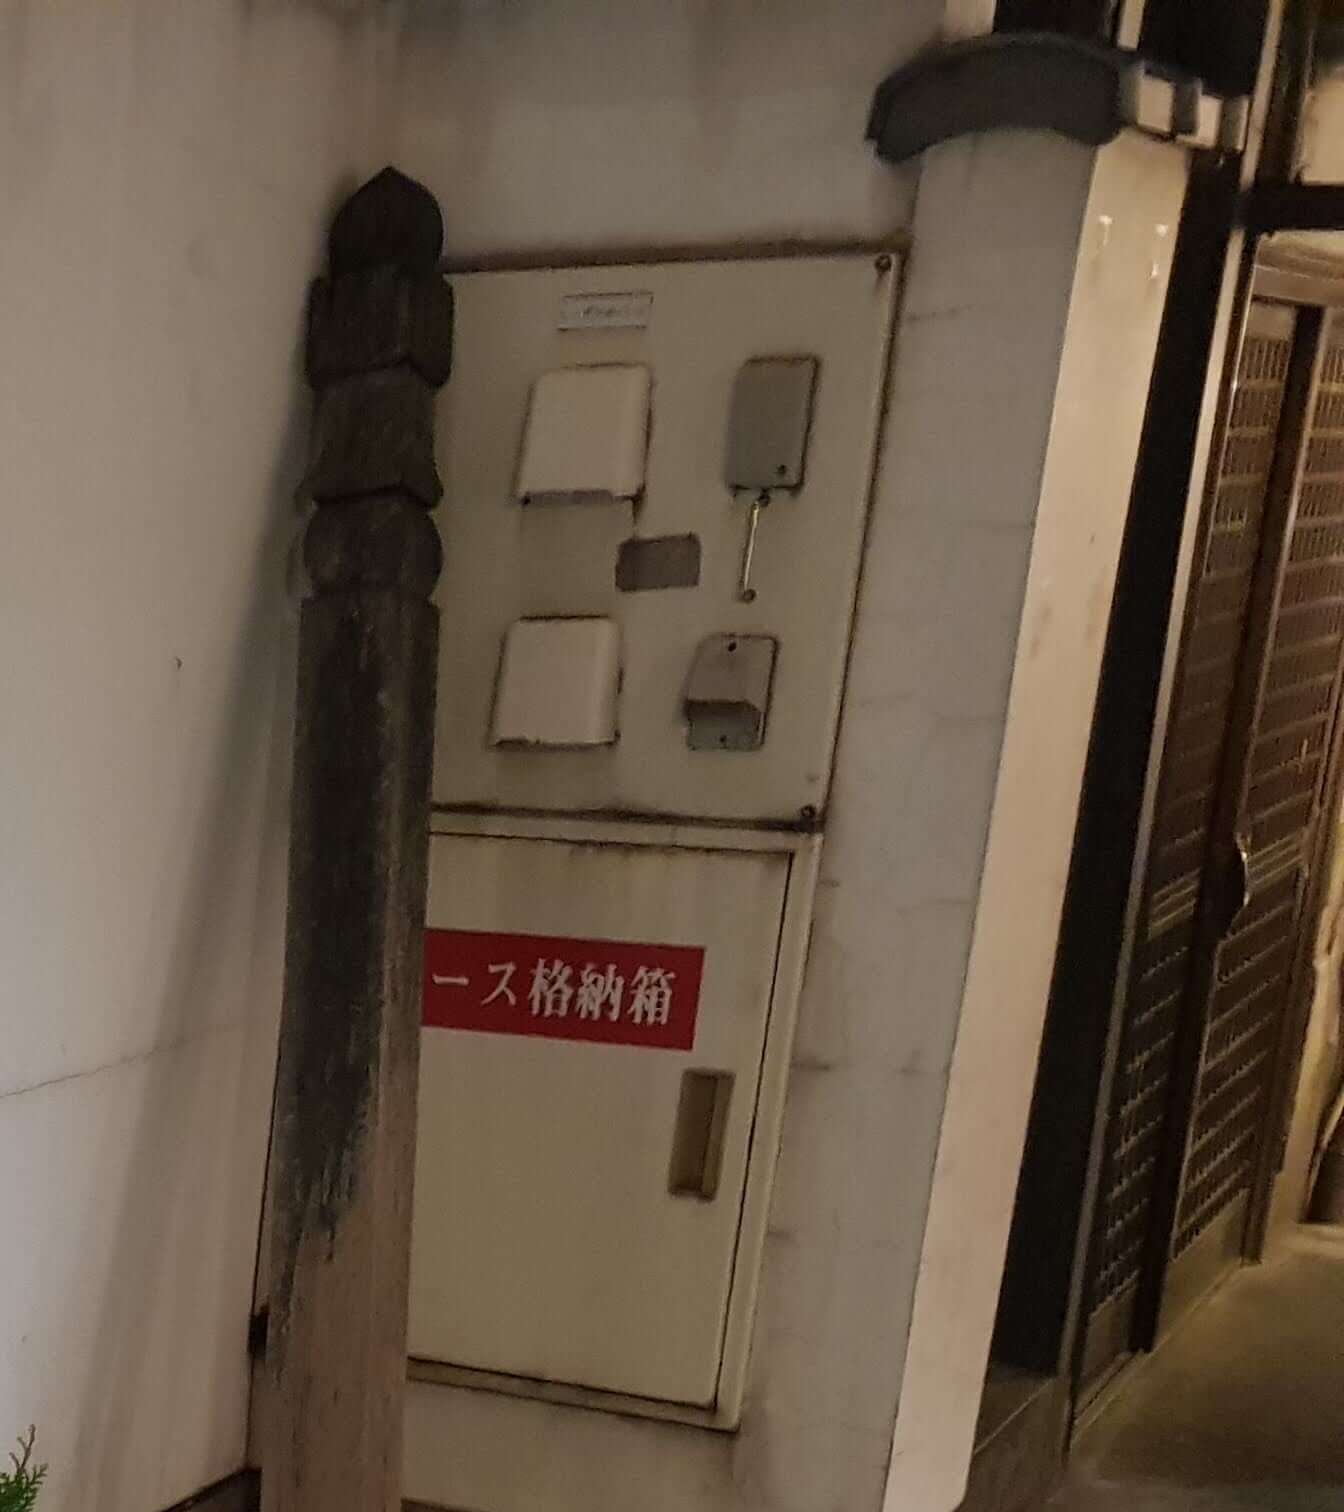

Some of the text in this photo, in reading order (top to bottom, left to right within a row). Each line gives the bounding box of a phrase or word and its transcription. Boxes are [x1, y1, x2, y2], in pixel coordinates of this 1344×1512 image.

[431, 956, 676, 1026] ース格納箱
